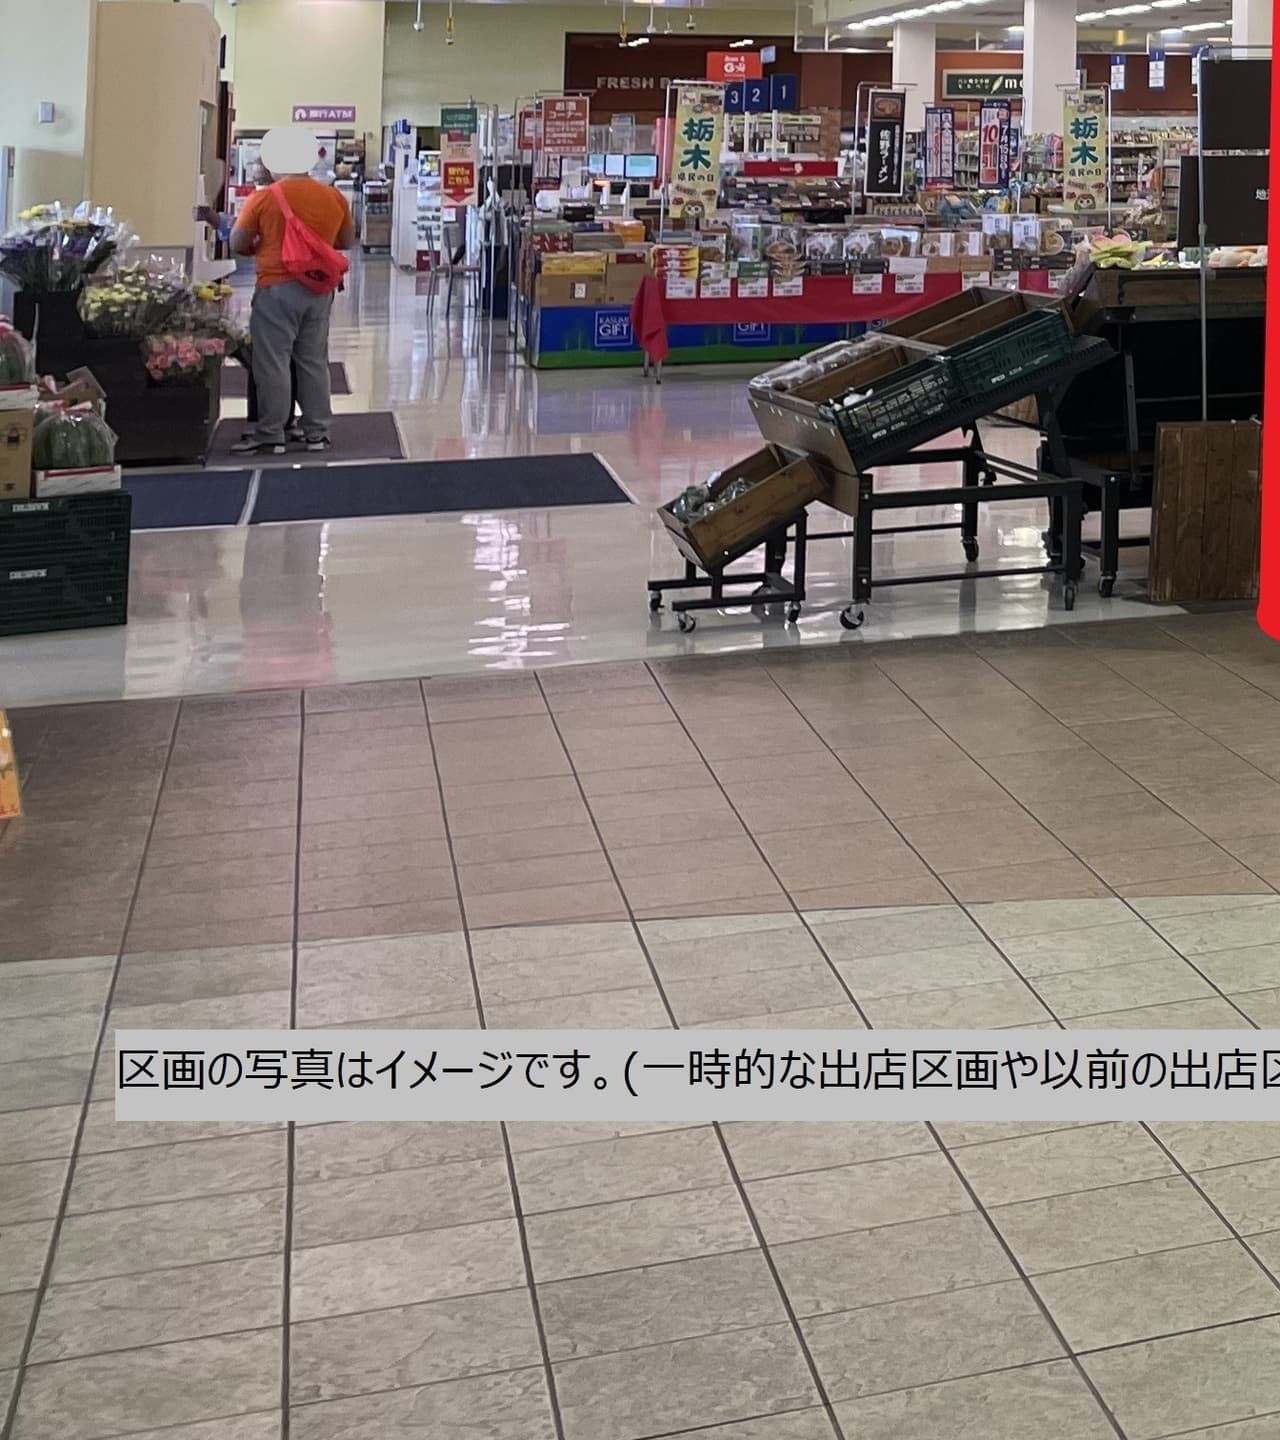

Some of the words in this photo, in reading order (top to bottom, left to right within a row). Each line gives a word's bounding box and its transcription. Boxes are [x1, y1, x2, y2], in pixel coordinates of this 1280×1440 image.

[596, 76, 654, 89] FRESH
[731, 90, 739, 104] 3
[751, 88, 760, 103] 2
[781, 84, 787, 100] 1
[681, 117, 715, 171] 栃木
[1069, 115, 1099, 166] 栃木
[678, 173, 715, 182] 県民の日
[1069, 168, 1102, 177] 県民の日
[599, 323, 629, 337] GIFT
